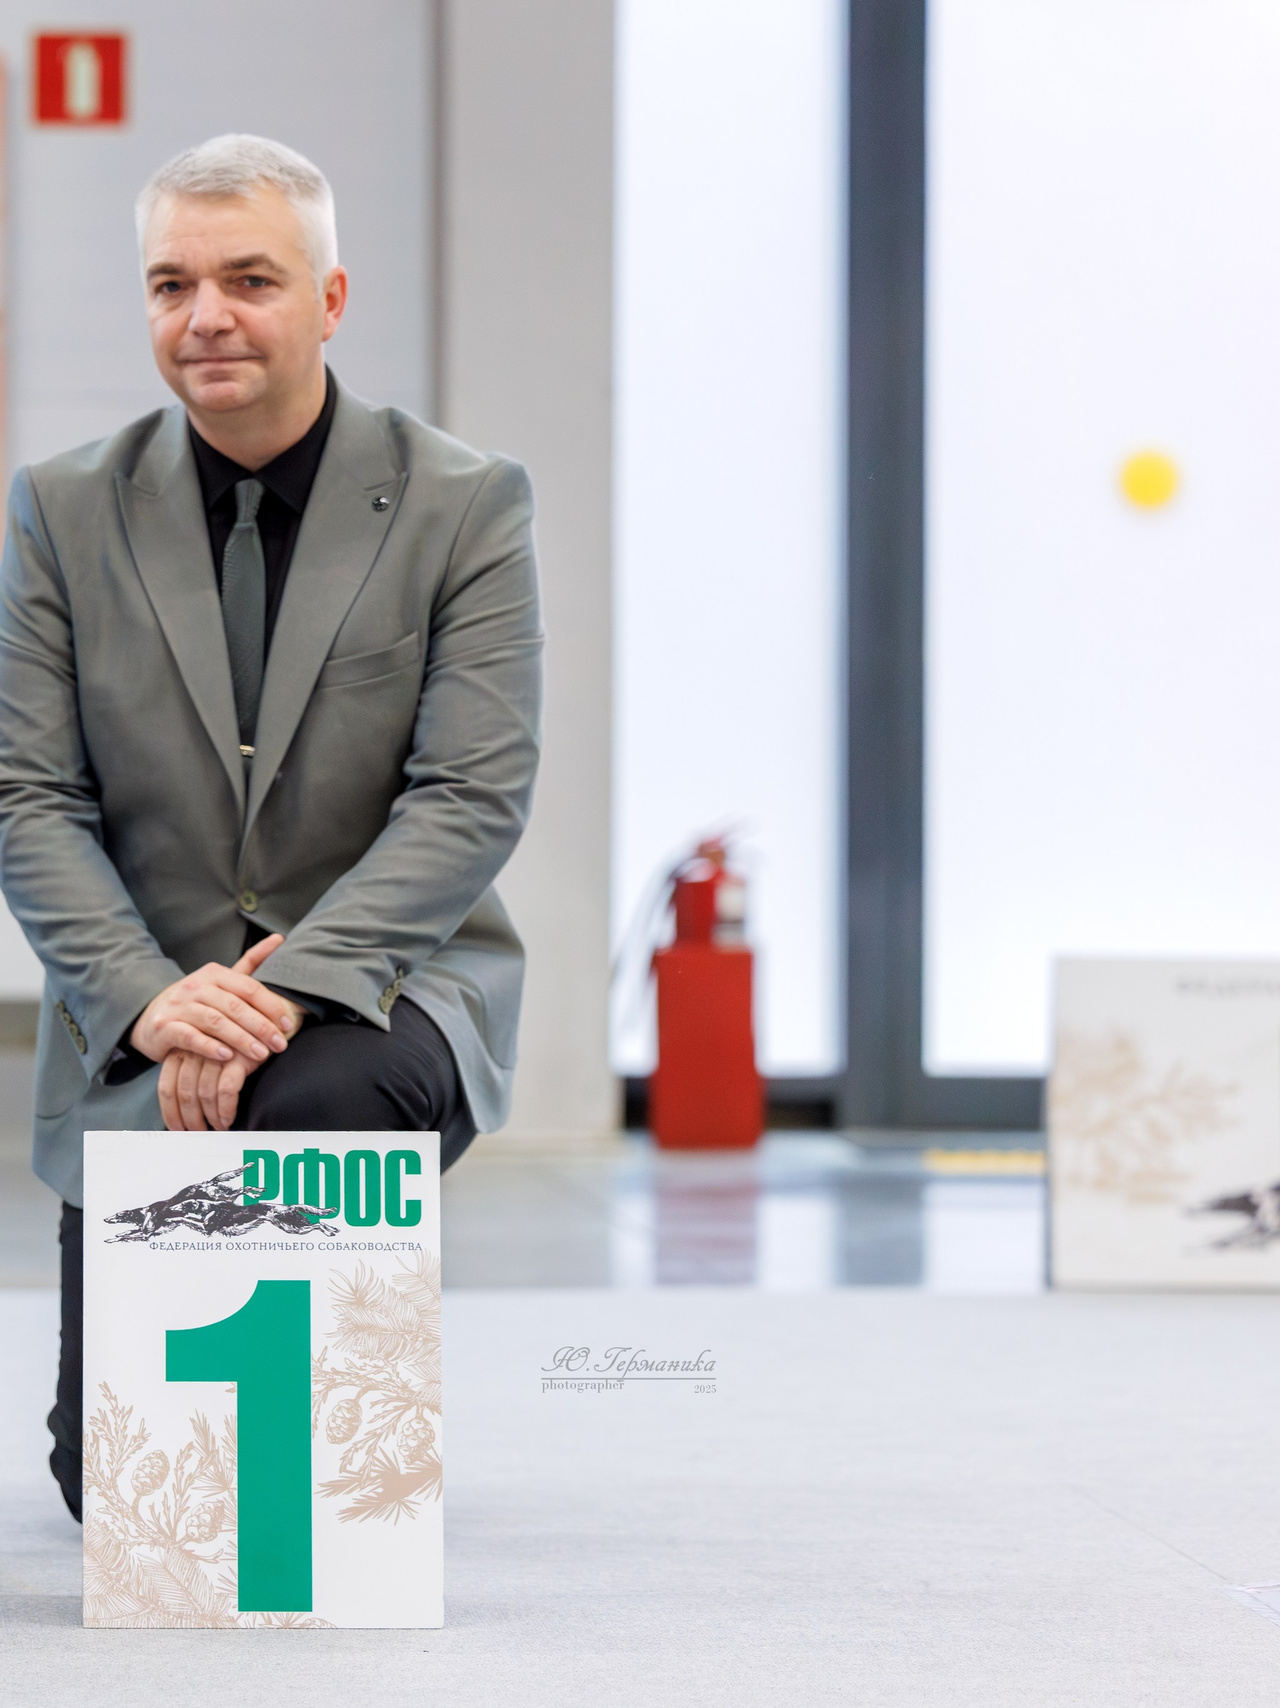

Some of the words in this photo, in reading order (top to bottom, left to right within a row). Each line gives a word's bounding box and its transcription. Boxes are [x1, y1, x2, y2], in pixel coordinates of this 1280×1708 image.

[243, 1148, 422, 1228] РФОС
[149, 1241, 222, 1252] ФЕДЕРАЦИЯ
[225, 1241, 315, 1251] ОХОТНИЧЬЕГО
[318, 1242, 422, 1252] СОБАКОВОДСТВА
[166, 1280, 312, 1612] 1
